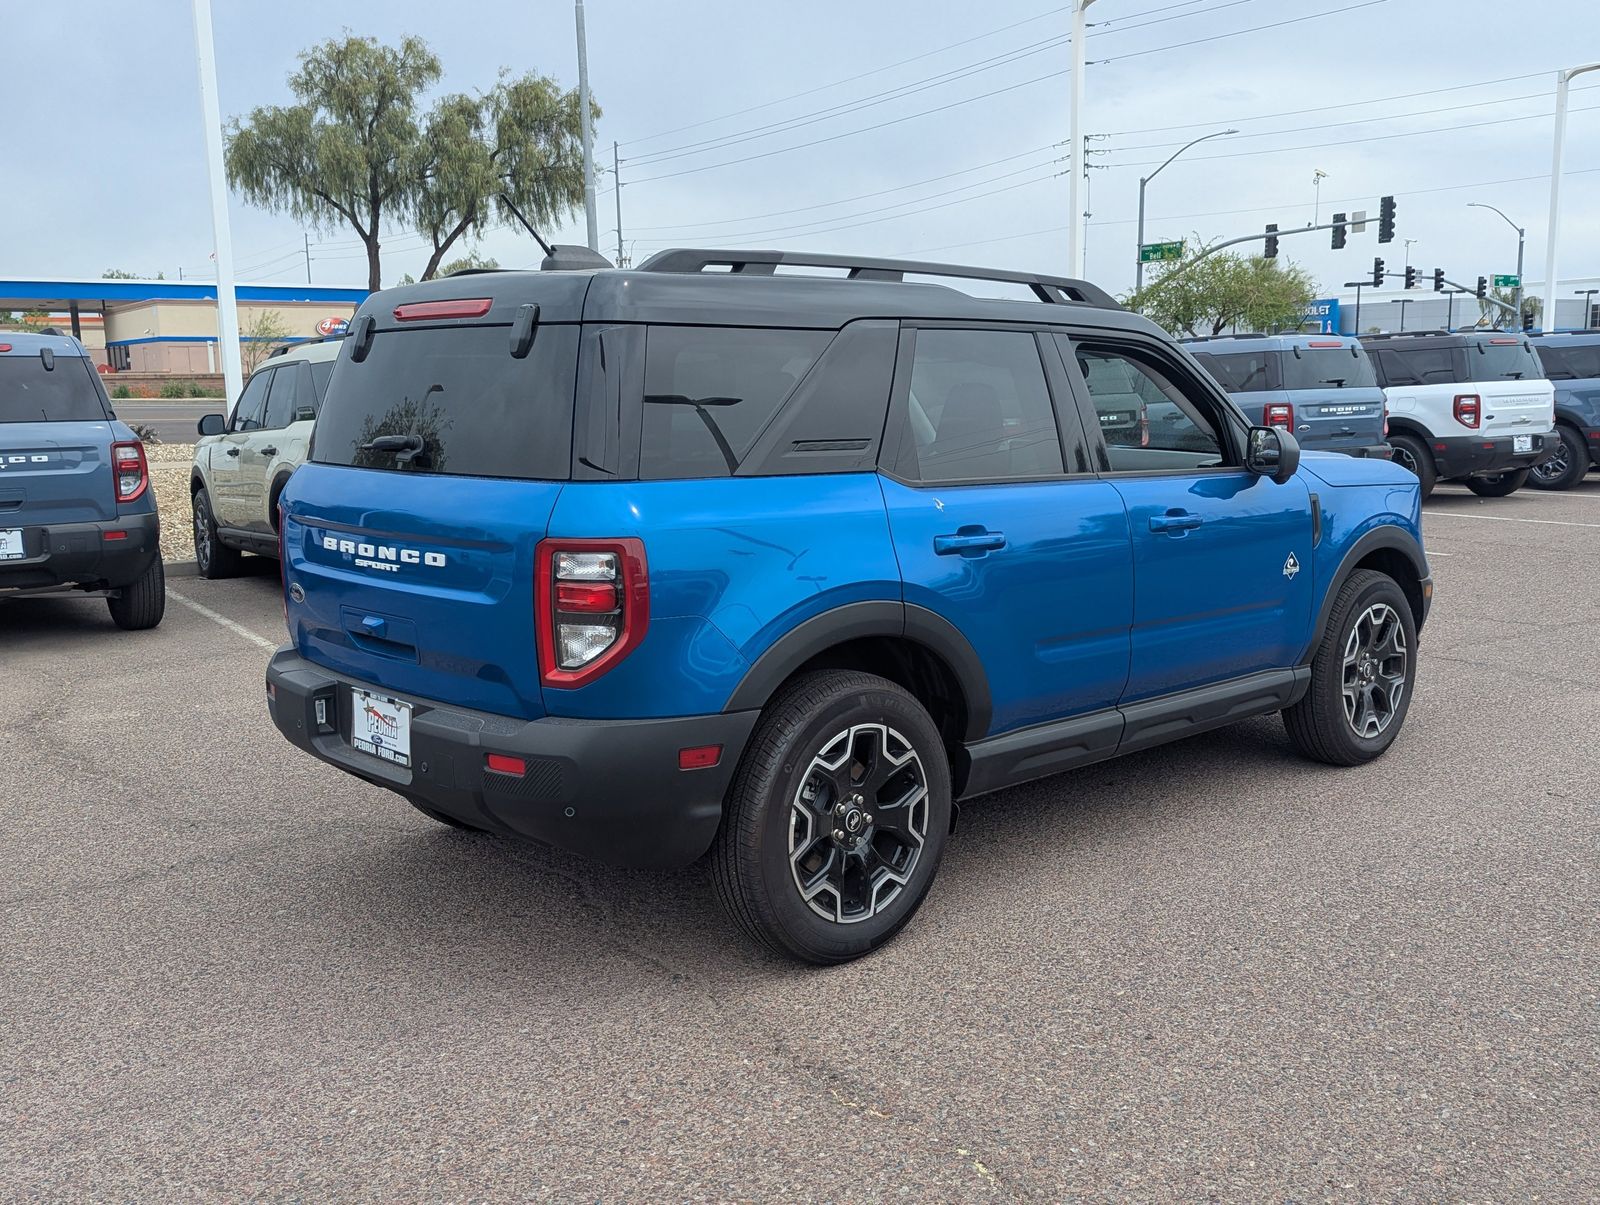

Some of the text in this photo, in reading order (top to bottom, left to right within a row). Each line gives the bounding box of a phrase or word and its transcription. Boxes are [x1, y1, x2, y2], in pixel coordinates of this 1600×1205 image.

[1149, 251, 1161, 260] Bell
[323, 536, 446, 567] BRONCO
[354, 558, 401, 572] SPORT
[367, 713, 398, 739] PEORIA
[354, 738, 377, 755] PEORIA
